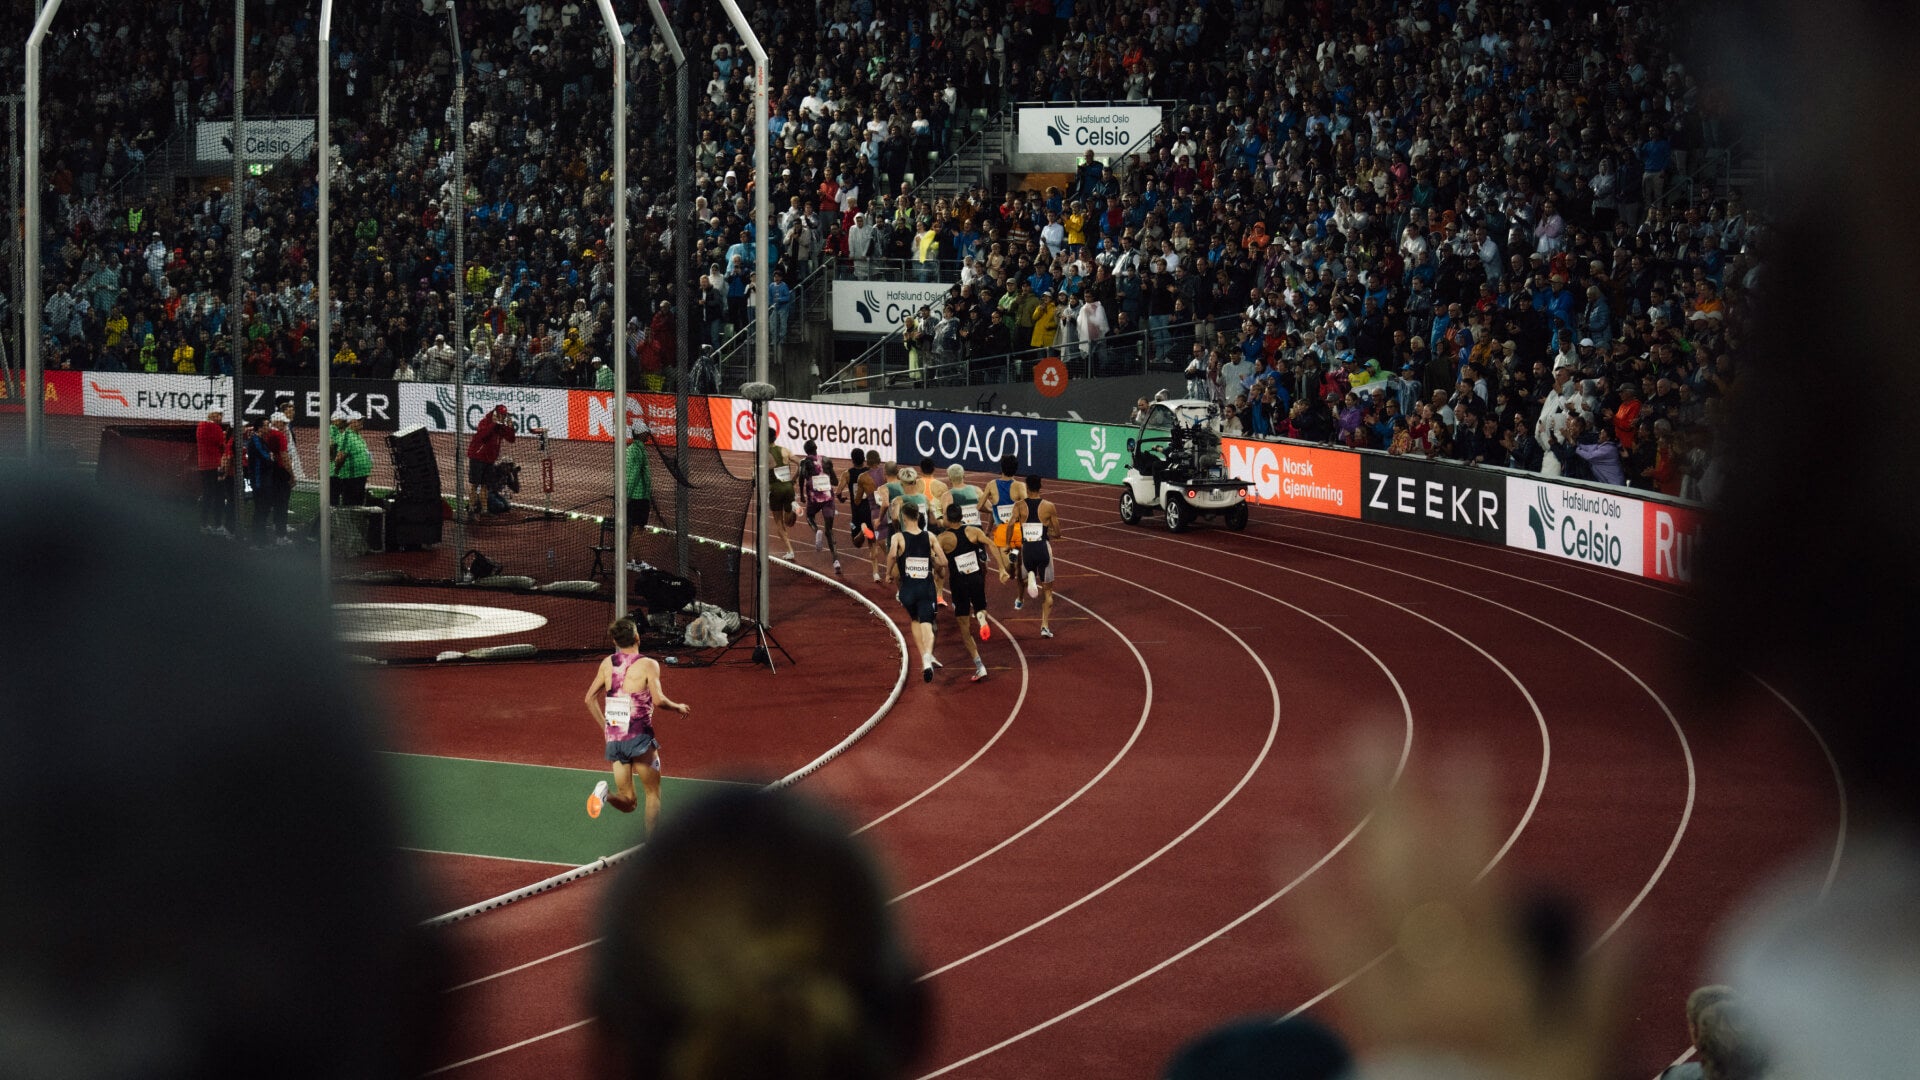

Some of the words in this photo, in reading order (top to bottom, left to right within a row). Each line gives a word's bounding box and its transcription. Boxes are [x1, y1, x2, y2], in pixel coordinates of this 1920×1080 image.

[1076, 114, 1110, 124] Hafslund
[1112, 114, 1130, 124] Oslo
[245, 137, 290, 153] Celsio
[1076, 126, 1130, 146] Celsio
[887, 291, 922, 301] Hafslund
[467, 388, 513, 402] Hafslund
[466, 404, 541, 433] Csio
[588, 395, 650, 439] NG
[648, 404, 680, 418] Nors
[787, 416, 893, 447] Storebrand
[1090, 427, 1106, 452] SJ
[1229, 444, 1280, 500] NG
[1282, 457, 1314, 477] Norsk
[1283, 478, 1343, 506] Gjenvinning
[1368, 472, 1500, 530] ZEEKR
[1562, 490, 1600, 514] Hafslund
[1602, 497, 1621, 519] Oslo
[1561, 515, 1622, 567] Celsio
[1655, 510, 1693, 584] Ru
